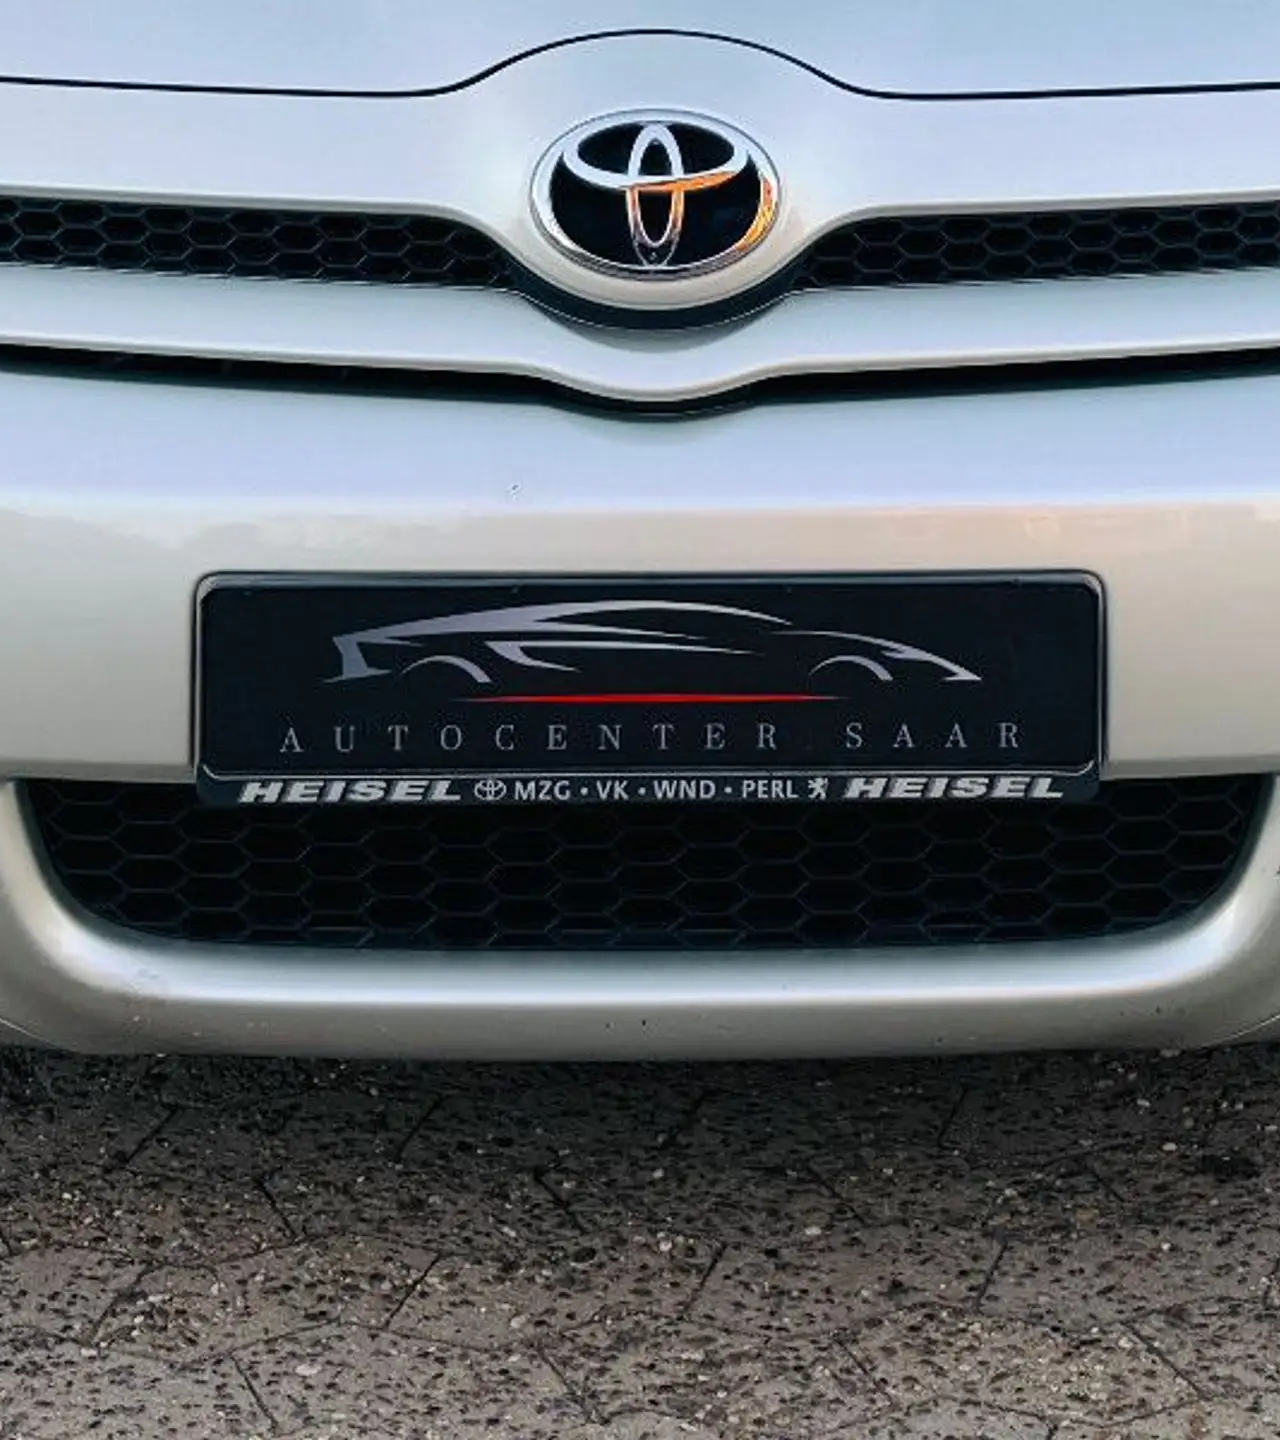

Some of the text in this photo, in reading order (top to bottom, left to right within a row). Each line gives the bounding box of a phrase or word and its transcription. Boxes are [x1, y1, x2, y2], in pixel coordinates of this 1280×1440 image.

[279, 721, 1019, 753] AUTOCENTER SAAR
[238, 776, 1065, 804] HEISEL MZG VK WND PERL HEISEL
